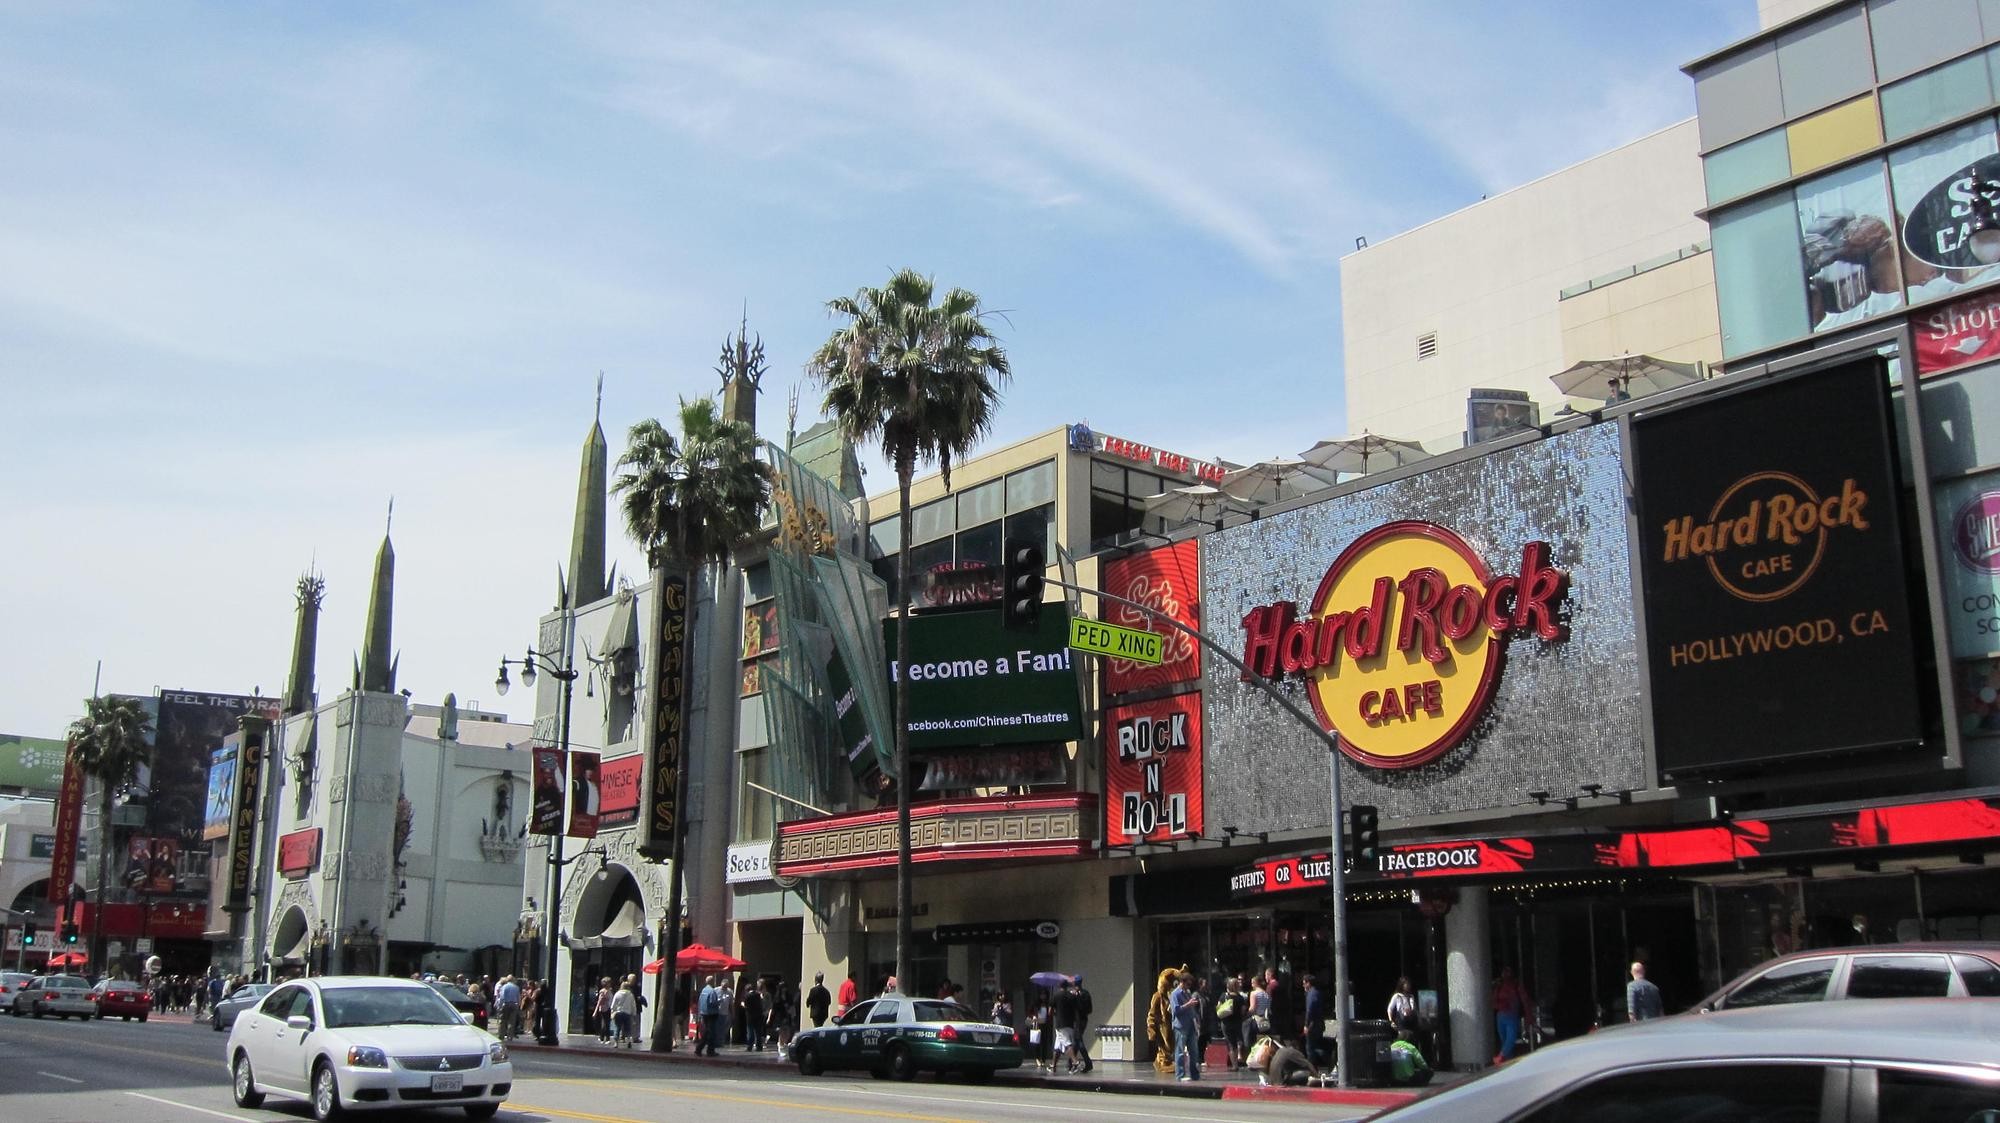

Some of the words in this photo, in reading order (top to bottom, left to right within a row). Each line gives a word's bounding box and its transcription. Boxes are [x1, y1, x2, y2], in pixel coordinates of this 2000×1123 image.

[1101, 436, 1151, 463] FRESH
[1155, 450, 1190, 473] FIRE
[1663, 499, 1761, 562] Hard
[1766, 478, 1870, 545] Rock
[1741, 554, 1793, 579] CAFE
[1242, 575, 1395, 683] Hard
[1397, 540, 1564, 663] Rock
[1077, 624, 1111, 648] PED
[1118, 632, 1156, 657] XING
[1670, 618, 1844, 667] HOLLYWOOD,
[1850, 610, 1889, 636] CA
[891, 658, 989, 682] ecome
[995, 656, 1010, 675] a
[1016, 646, 1071, 673] Fan!
[164, 693, 204, 705] FEEL
[208, 696, 239, 708] THE
[1359, 680, 1443, 726] CAFE
[907, 711, 1070, 732] acebook.com/ChineseTheatres
[1118, 713, 1187, 757] ROCK
[233, 745, 260, 890] CHINESE
[1121, 791, 1187, 835] ROLL
[730, 855, 759, 873] See's
[1239, 870, 1265, 888] EVENTS
[1275, 866, 1290, 882] OR
[1387, 848, 1477, 871] FACEBOOK
[864, 1038, 879, 1047] TAXI
